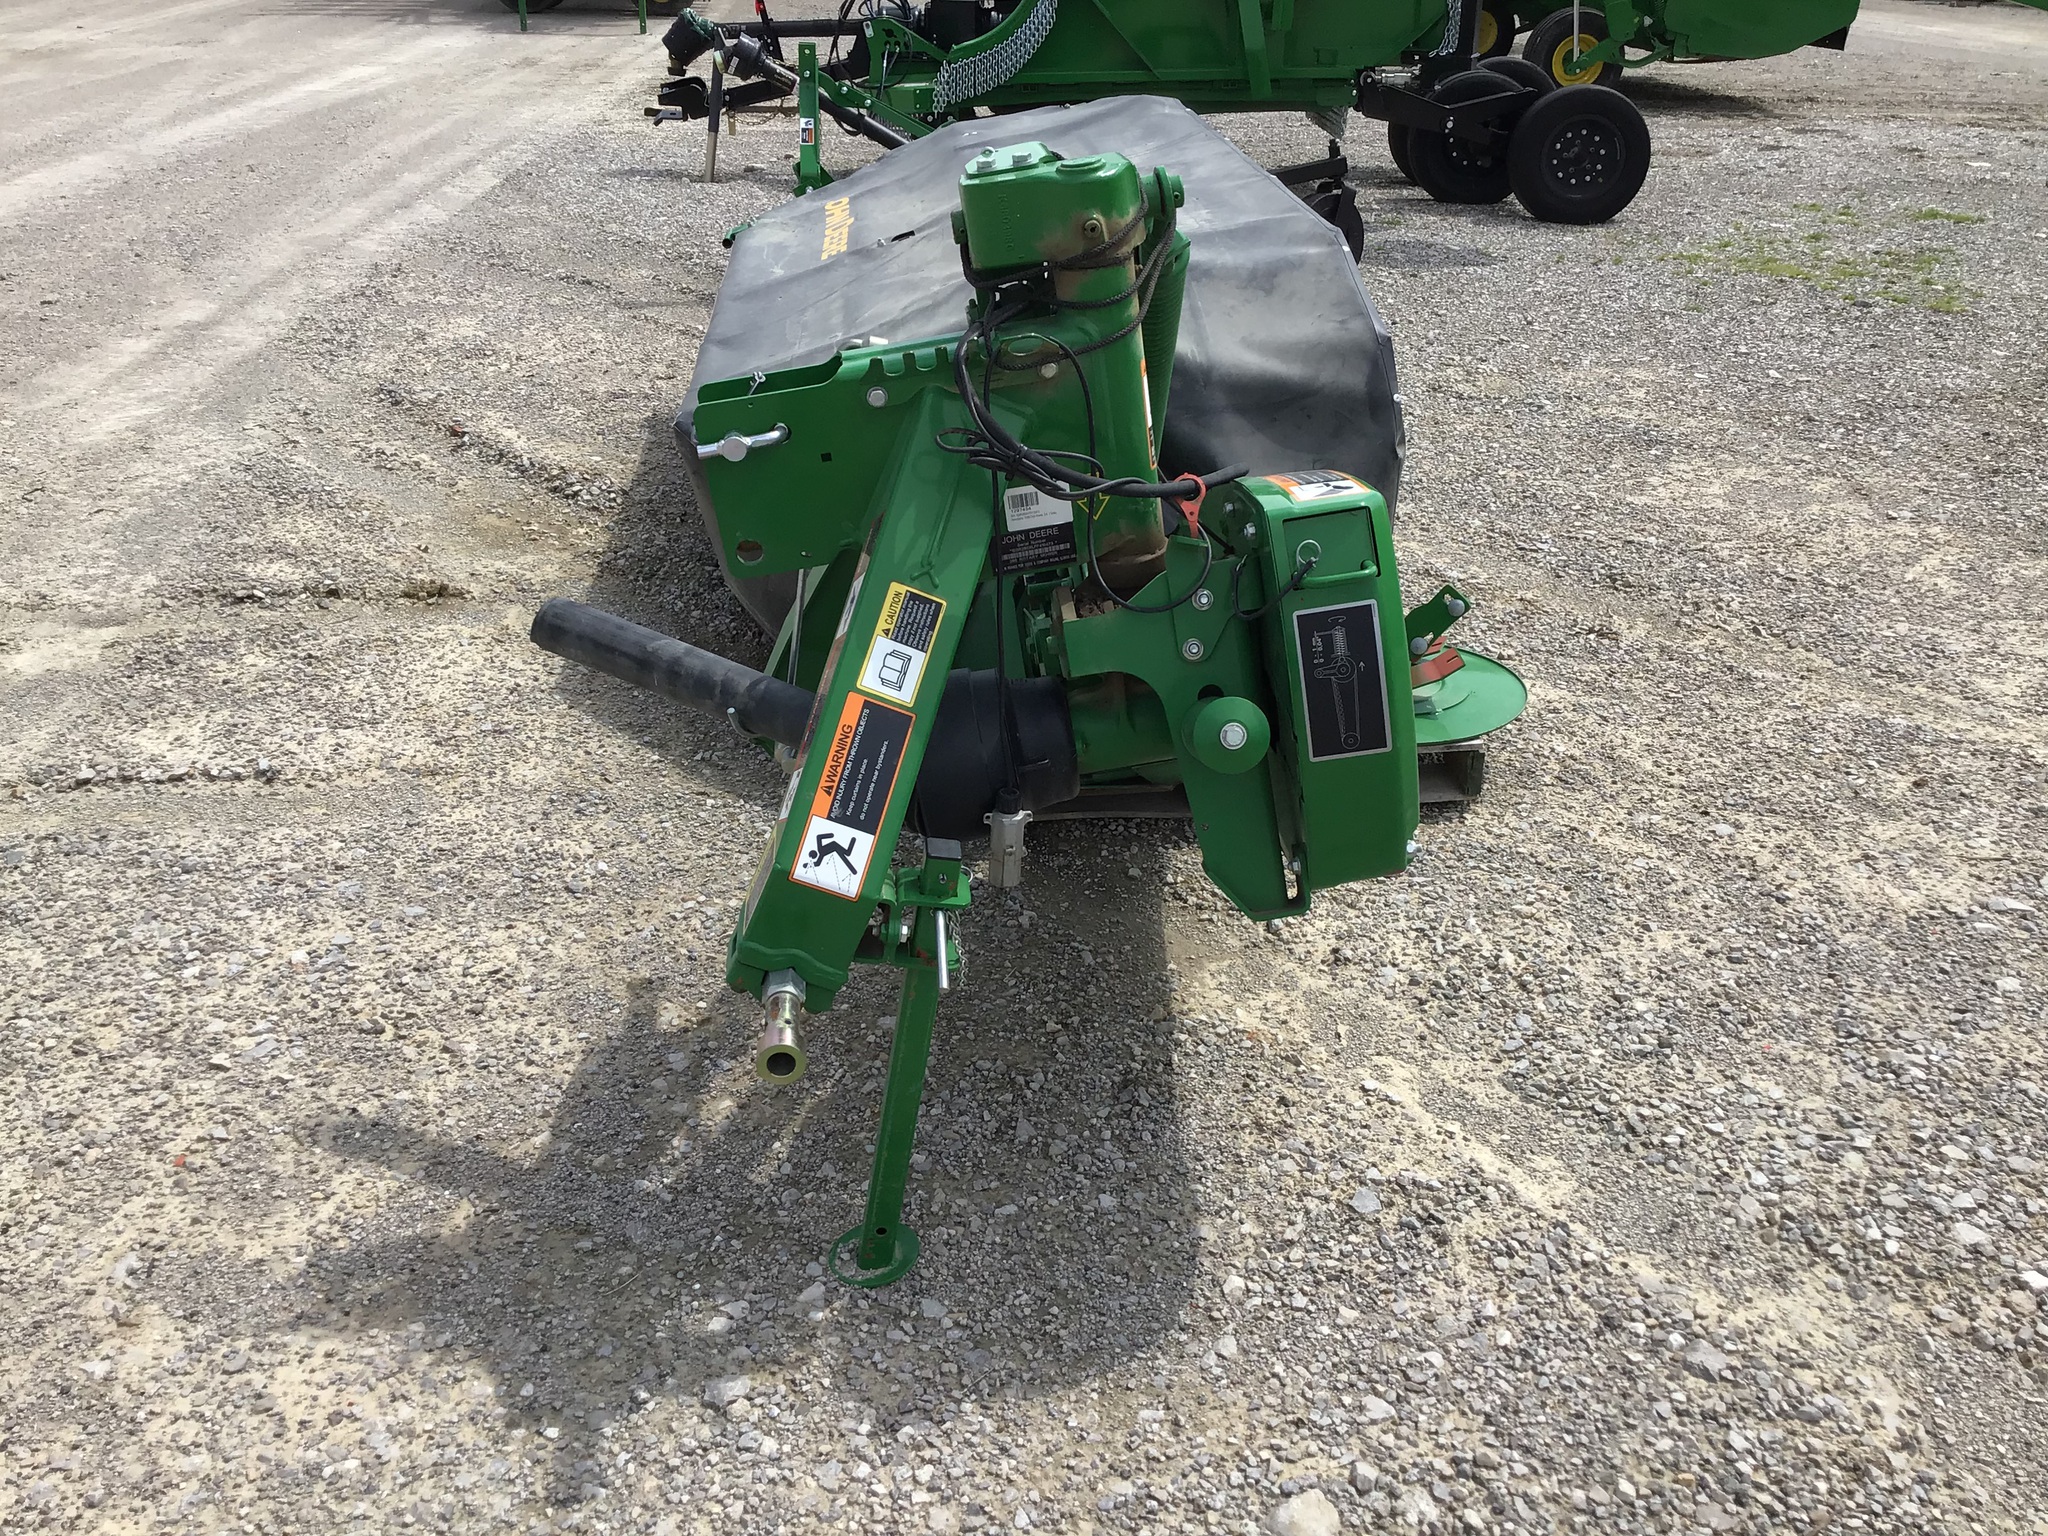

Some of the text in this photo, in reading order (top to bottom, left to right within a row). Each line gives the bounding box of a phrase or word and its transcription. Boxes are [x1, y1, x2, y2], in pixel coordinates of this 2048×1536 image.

[824, 197, 850, 230] OHN
[1001, 527, 1060, 545] JOHN DEERE
[885, 591, 902, 625] CAUTION
[825, 724, 852, 783] WARNING
[830, 709, 869, 818] AVOID INJURY FROM THROWN OBJECTS
[865, 782, 875, 803] operate
[875, 740, 888, 769] bystanders.
[846, 801, 854, 815] Keep
[851, 780, 861, 801] curtains
[860, 759, 868, 773] place.
